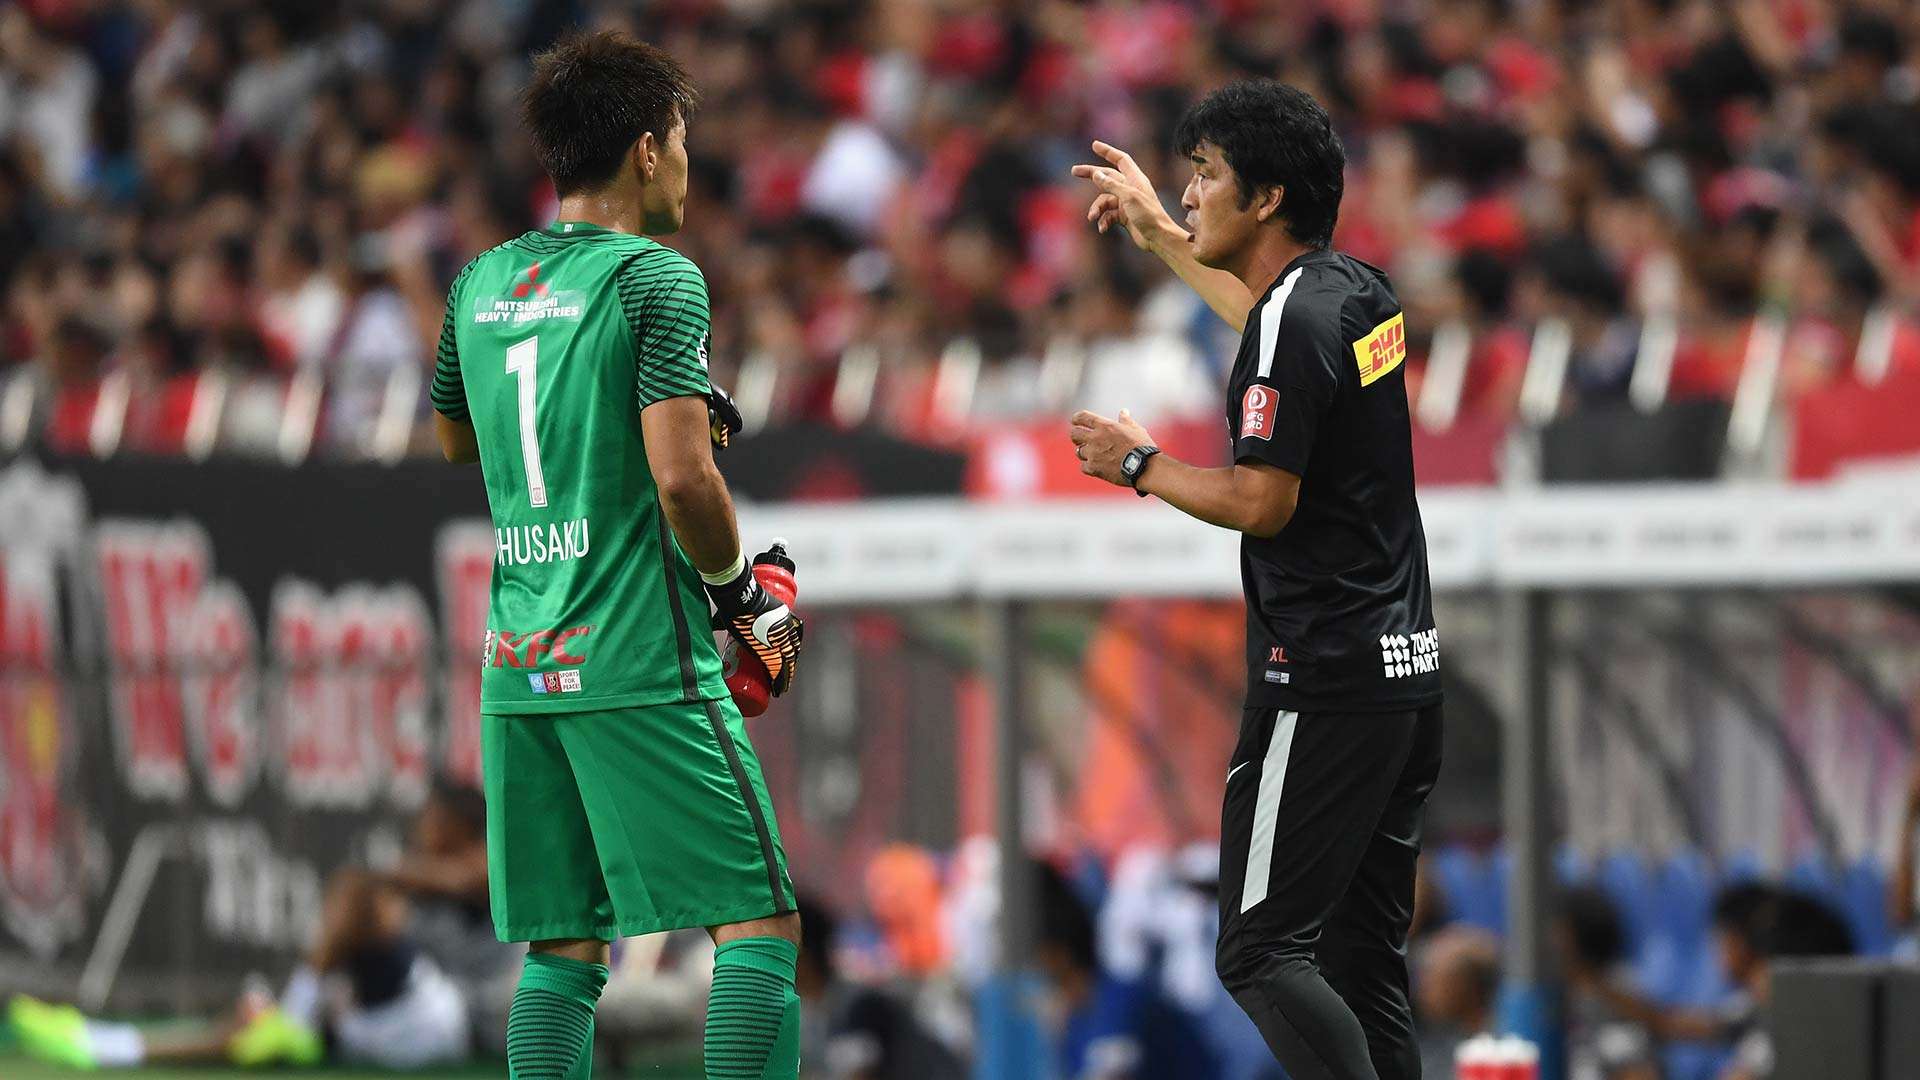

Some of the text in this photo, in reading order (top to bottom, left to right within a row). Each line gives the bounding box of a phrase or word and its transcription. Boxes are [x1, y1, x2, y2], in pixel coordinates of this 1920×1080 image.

[474, 311, 510, 323] HEAVY
[506, 335, 548, 507] 1
[495, 517, 590, 567] HUSAKU
[493, 625, 591, 668] KFC
[1269, 647, 1288, 662] XL
[559, 670, 579, 679] SPORTS
